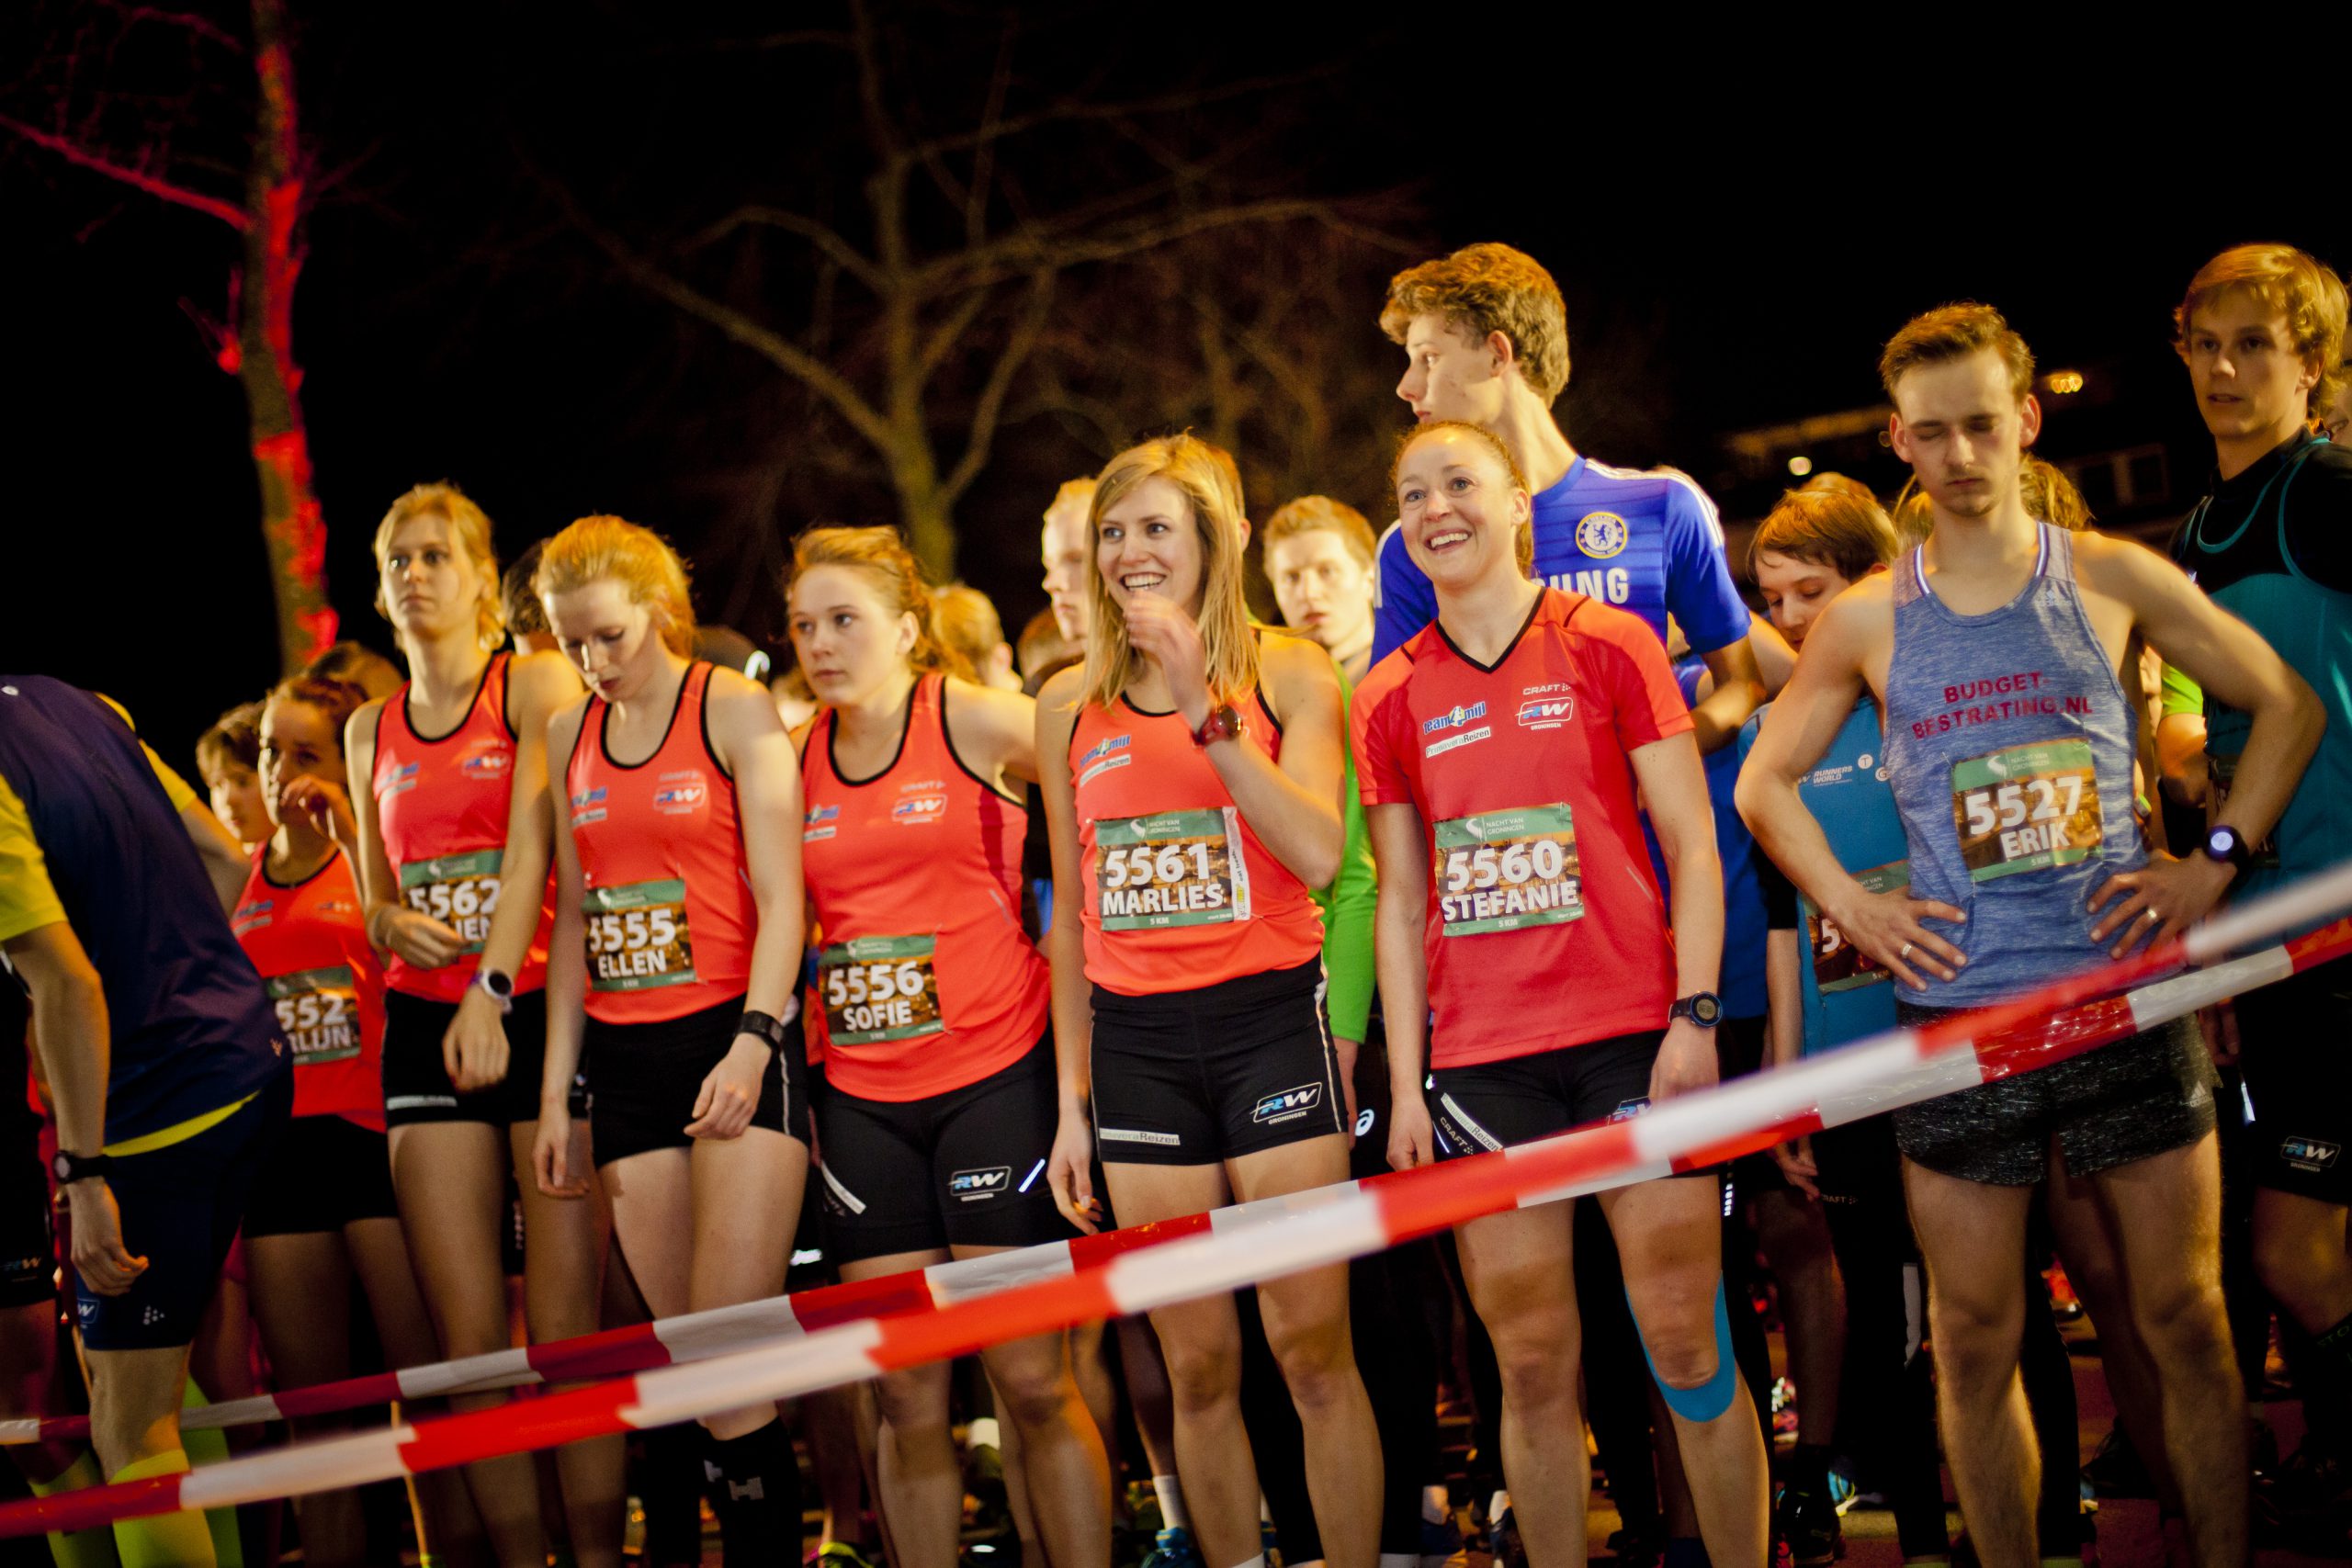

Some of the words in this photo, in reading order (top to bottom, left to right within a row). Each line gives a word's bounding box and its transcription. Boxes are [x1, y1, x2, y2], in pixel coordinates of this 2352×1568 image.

[1522, 683, 1560, 695] CRAFT
[1943, 671, 2051, 705] BUDGET-
[1424, 701, 1486, 733] team4mijl
[1531, 723, 1562, 731] GRONINGEN
[1912, 696, 2093, 739] BESTRATING.NL
[1426, 729, 1489, 757] PrimaveraReizen
[1813, 773, 1842, 784] WORLD
[1815, 765, 1852, 778] RUNNERS
[1964, 776, 2082, 834] 5527
[1487, 825, 1525, 836] GRONINGEN
[2000, 821, 2071, 860] ERIK
[1105, 842, 1211, 887] 5561
[1447, 840, 1563, 892] 5560
[409, 879, 501, 919] 5562
[1102, 883, 1225, 917] MARLIES
[1441, 881, 1579, 922] STEFANIE
[589, 908, 675, 953] 5555
[1157, 917, 1170, 925] KM
[1505, 919, 1519, 927] KM
[598, 949, 667, 979] ELLEN
[828, 961, 923, 1006] 5556
[276, 994, 347, 1032] 552
[843, 1000, 912, 1031] SOFIE
[1268, 1111, 1307, 1125] GRONINGEN
[1441, 1117, 1468, 1146] CRAFT
